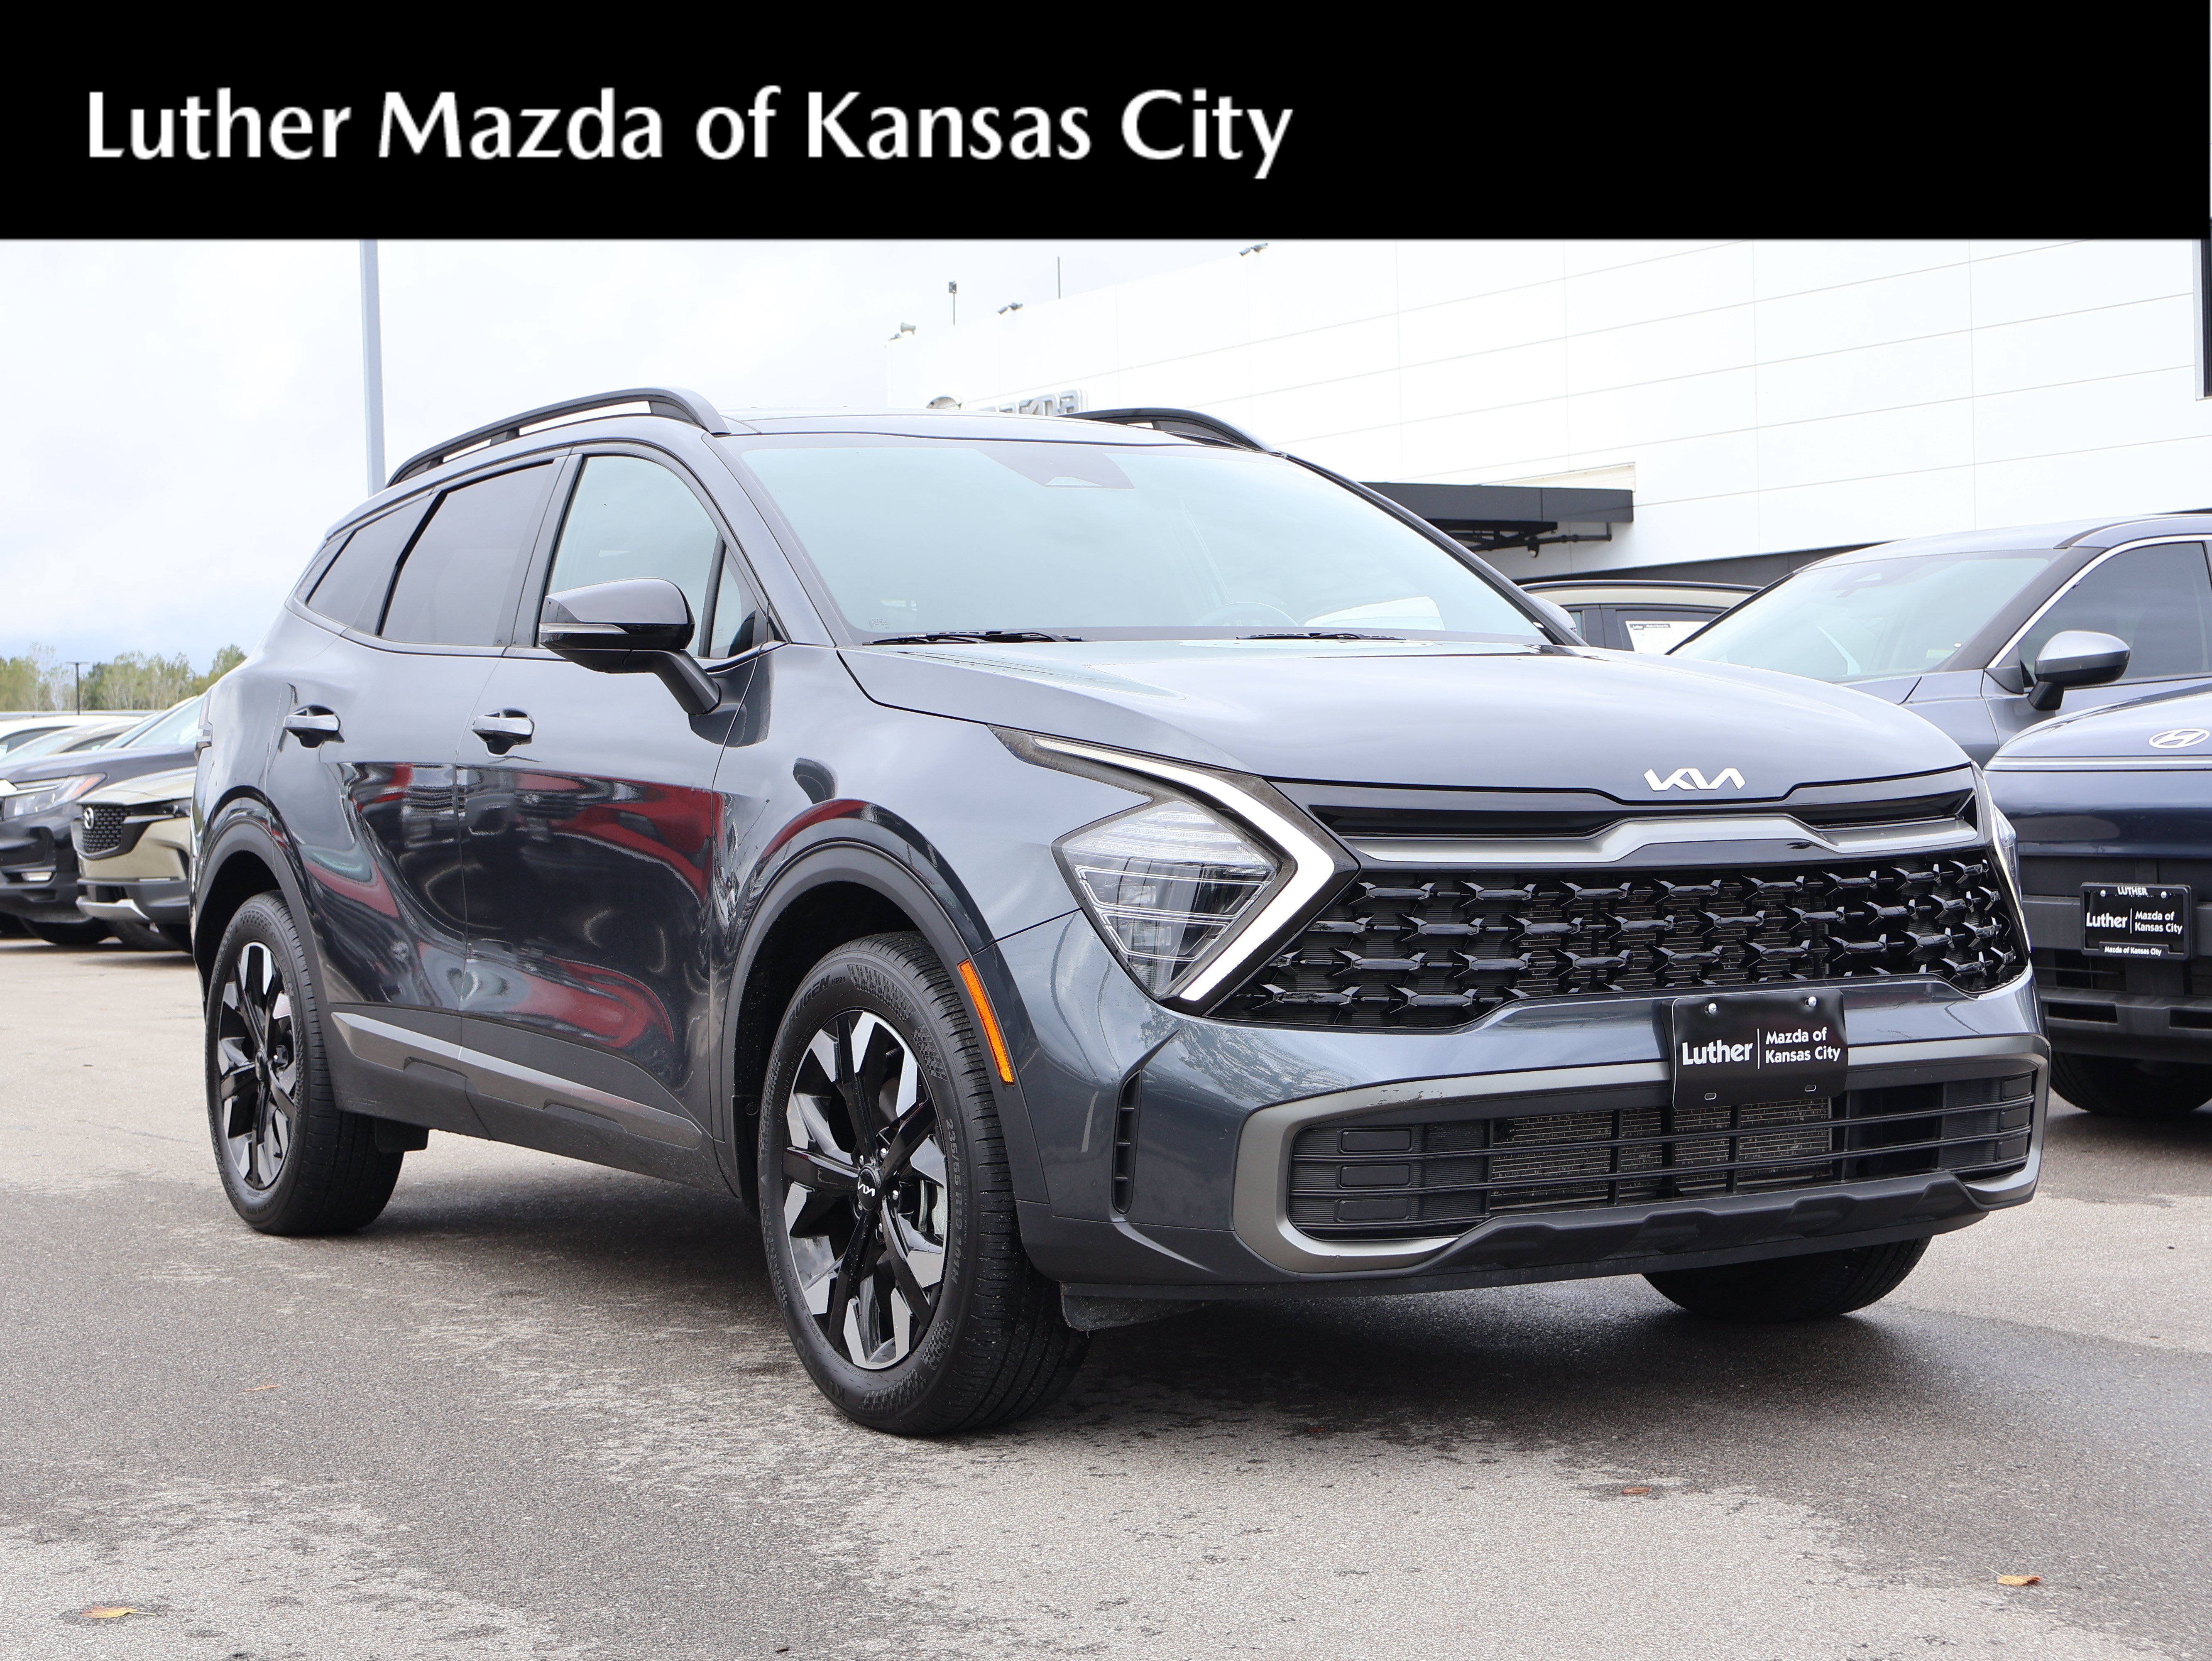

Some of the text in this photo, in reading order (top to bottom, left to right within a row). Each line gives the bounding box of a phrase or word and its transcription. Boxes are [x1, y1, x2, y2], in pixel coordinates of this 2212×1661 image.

[1644, 768, 1746, 791] KIA
[2117, 885, 2148, 897] LUTHER
[2086, 912, 2128, 928] Luther
[2135, 911, 2175, 921] Mazda of
[2135, 922, 2183, 935] Kansas City
[2104, 945, 2122, 953] Mazda
[2130, 947, 2150, 955] Kansas
[2150, 947, 2162, 957] City
[782, 974, 831, 1045] CRUGEN
[832, 976, 846, 986] HP71
[1765, 1026, 1827, 1045] Mazda of
[1681, 1039, 1753, 1066] Luther
[1765, 1045, 1841, 1063] Kansas City
[946, 1118, 963, 1285] 235/55 R19 101H
[827, 1349, 849, 1372] TUBELESS
